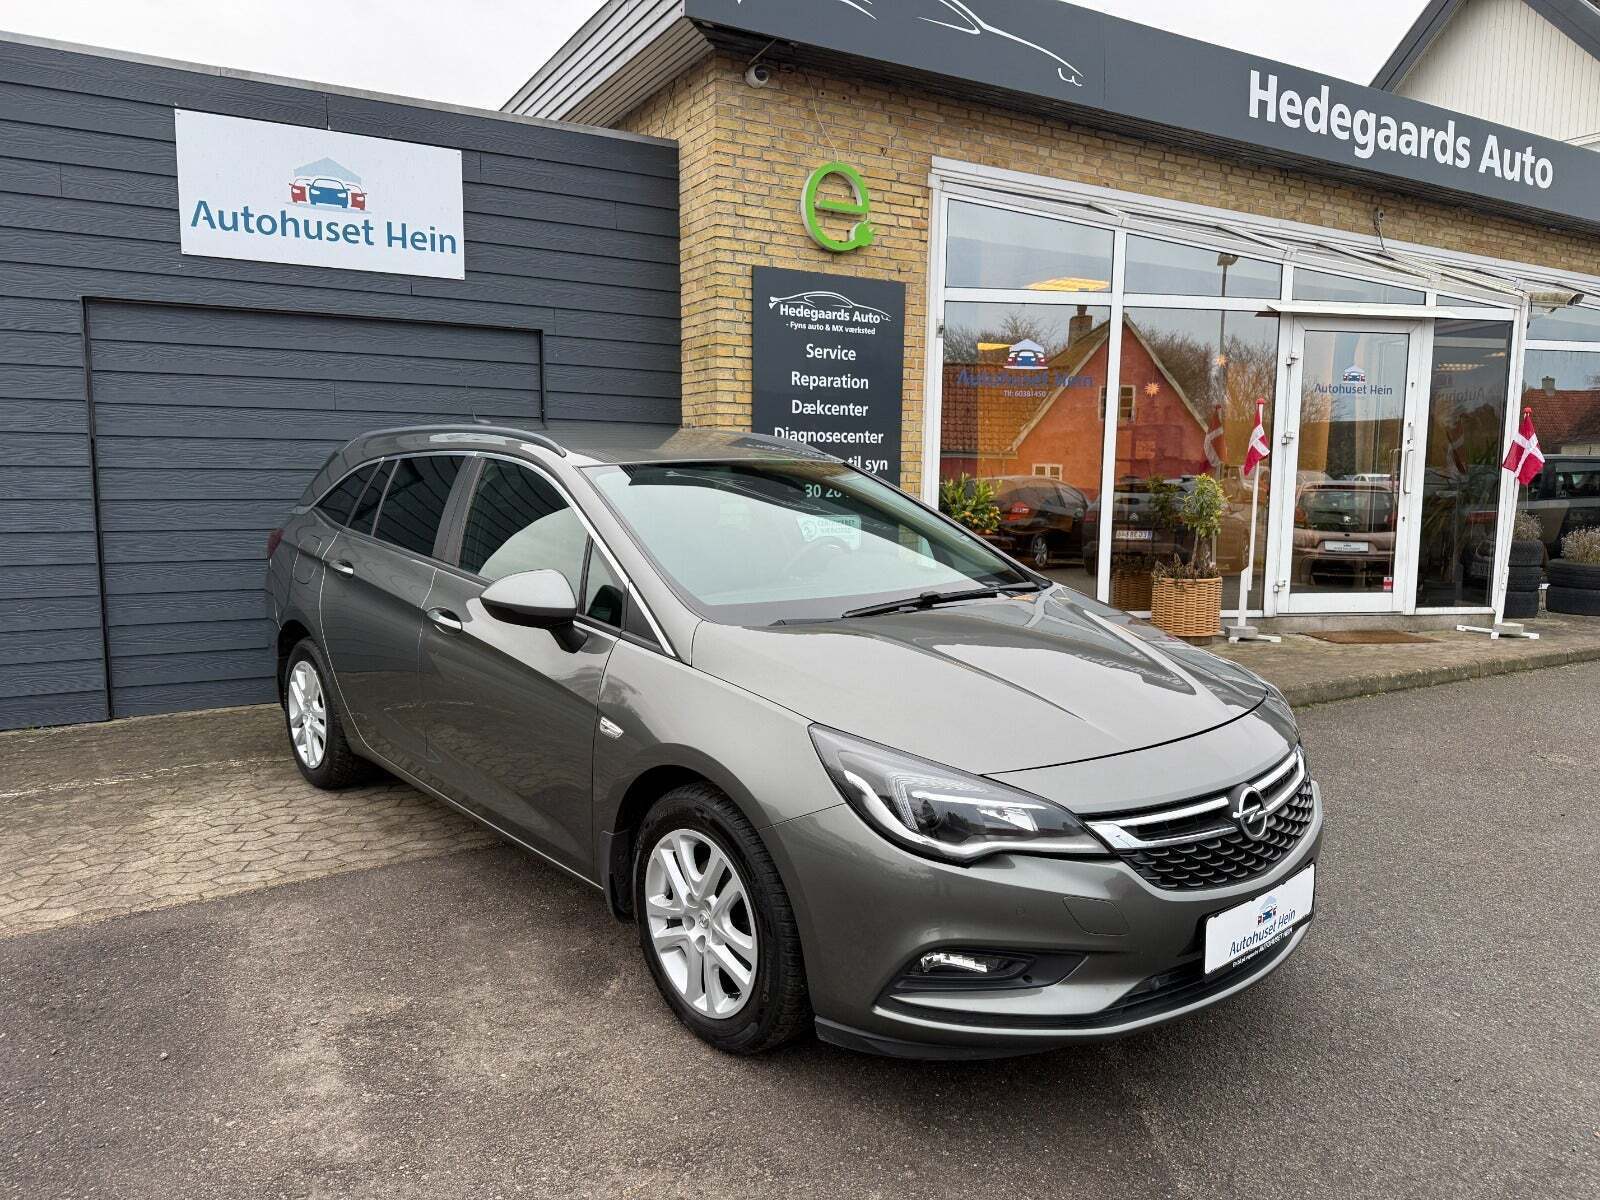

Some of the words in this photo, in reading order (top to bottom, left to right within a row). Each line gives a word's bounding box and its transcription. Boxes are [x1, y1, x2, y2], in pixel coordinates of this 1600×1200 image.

[1249, 69, 1471, 169] Hedegaards
[1478, 134, 1553, 189] Auto
[191, 200, 375, 246] Autohuset
[386, 221, 457, 254] Hein
[780, 303, 850, 322] Hedegaards
[852, 311, 881, 324] Auto
[790, 321, 807, 331] Fyns
[807, 323, 825, 332] auto
[825, 323, 831, 332] &
[831, 324, 844, 333] MX
[845, 326, 876, 335] værksted
[806, 343, 857, 361] Service
[791, 370, 869, 391] Reparation
[1314, 383, 1367, 395] Autohuset
[1370, 384, 1393, 395] Hein
[791, 399, 869, 417] Dækcenter
[774, 426, 885, 445] Diagnosecenter
[865, 459, 888, 474] syn
[804, 483, 822, 498] 30
[1229, 919, 1278, 957] Autohuset
[1278, 908, 1296, 930] Hein
